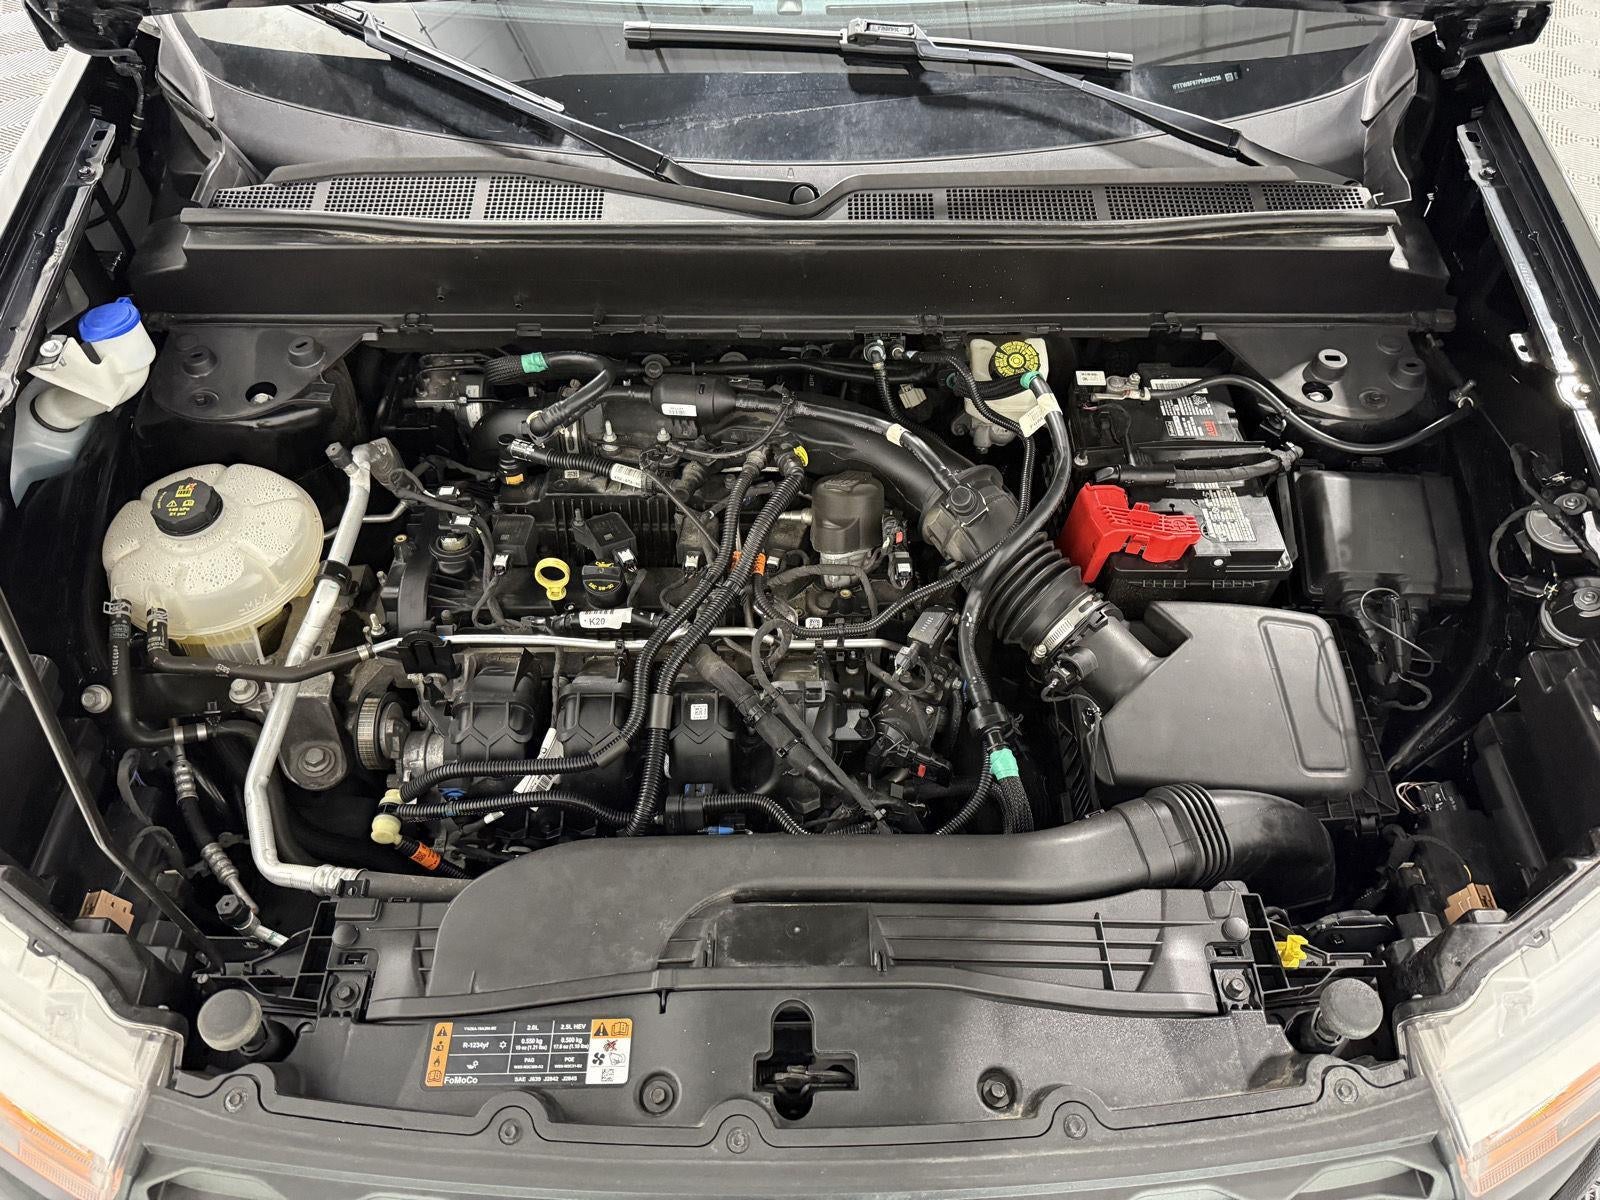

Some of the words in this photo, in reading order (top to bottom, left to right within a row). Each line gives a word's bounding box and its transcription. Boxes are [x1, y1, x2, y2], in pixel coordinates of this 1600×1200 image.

[589, 616, 606, 626] K20
[462, 1041, 489, 1050] R-1234yf
[444, 1076, 478, 1084] FoMoCo
